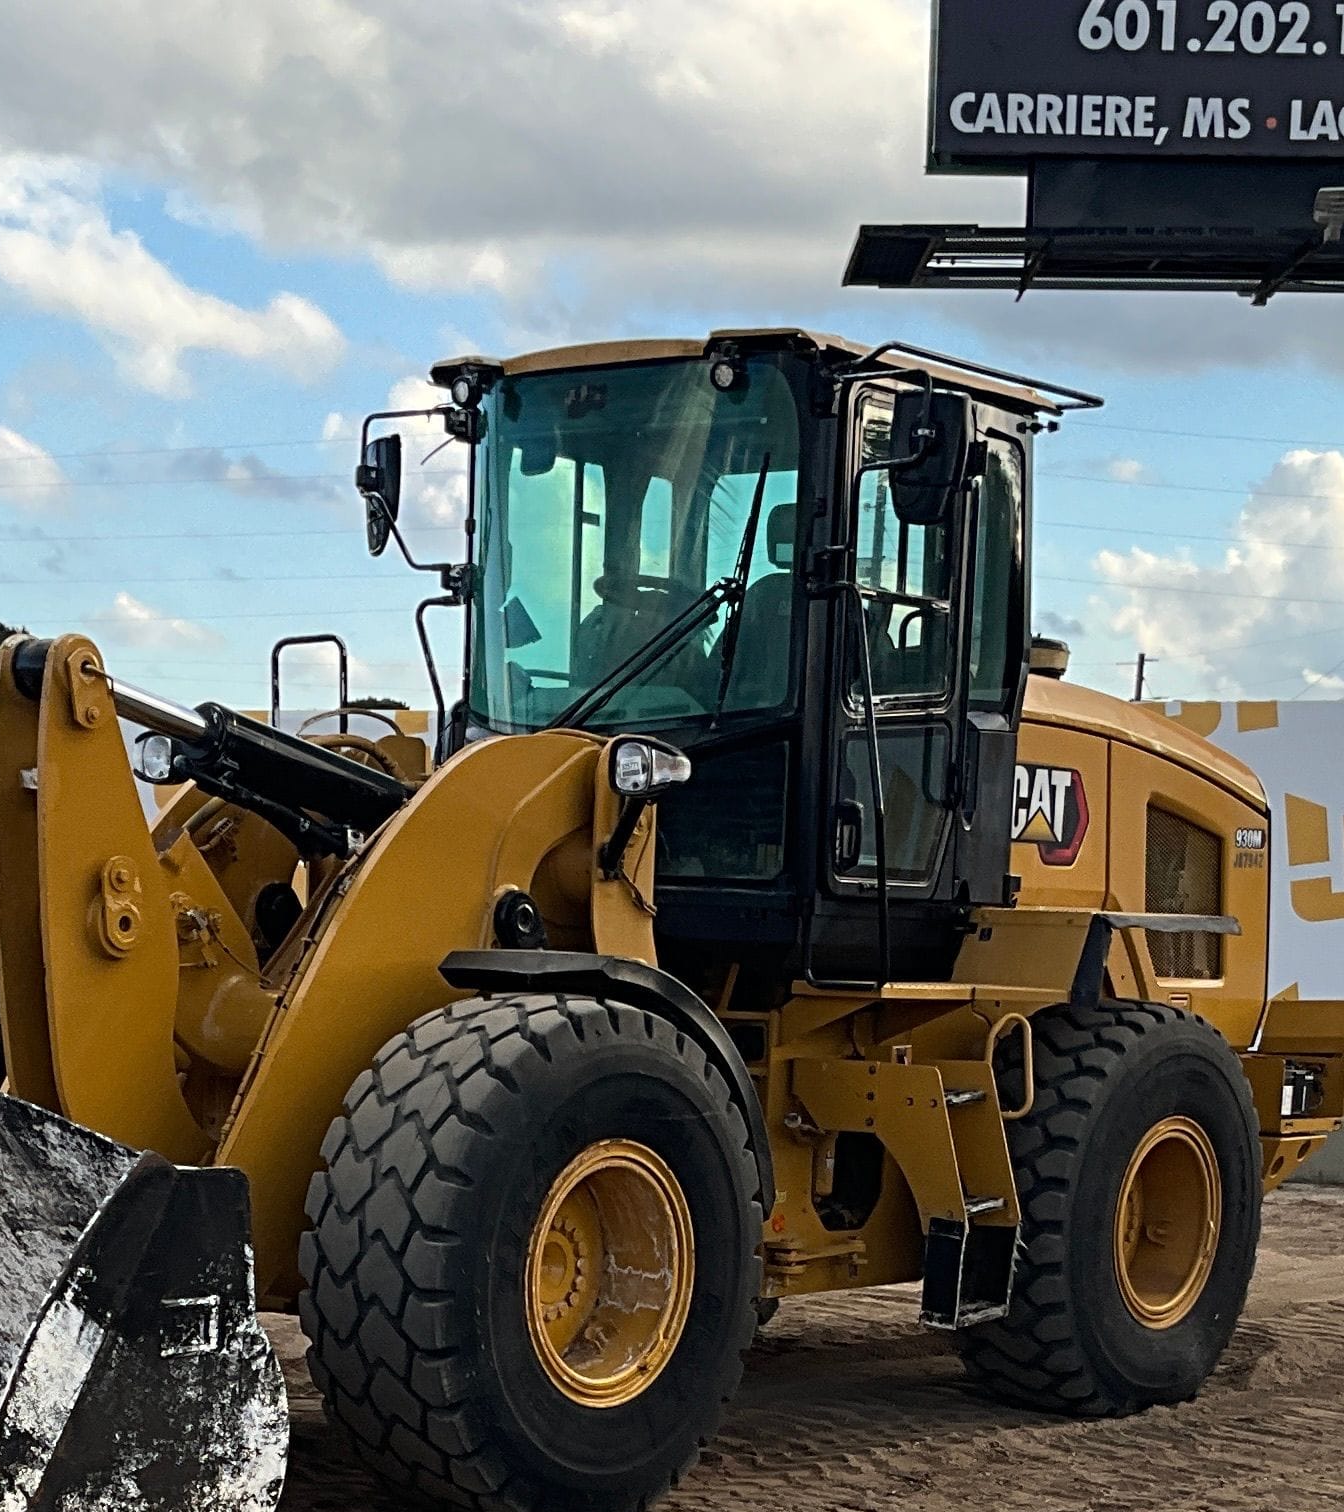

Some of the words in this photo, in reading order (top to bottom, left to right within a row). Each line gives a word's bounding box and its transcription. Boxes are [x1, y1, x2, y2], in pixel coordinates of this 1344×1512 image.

[949, 92, 1169, 145] CARRIERE,
[1182, 97, 1252, 140] MS
[1011, 765, 1072, 842] CAT
[1236, 829, 1263, 848] 930M
